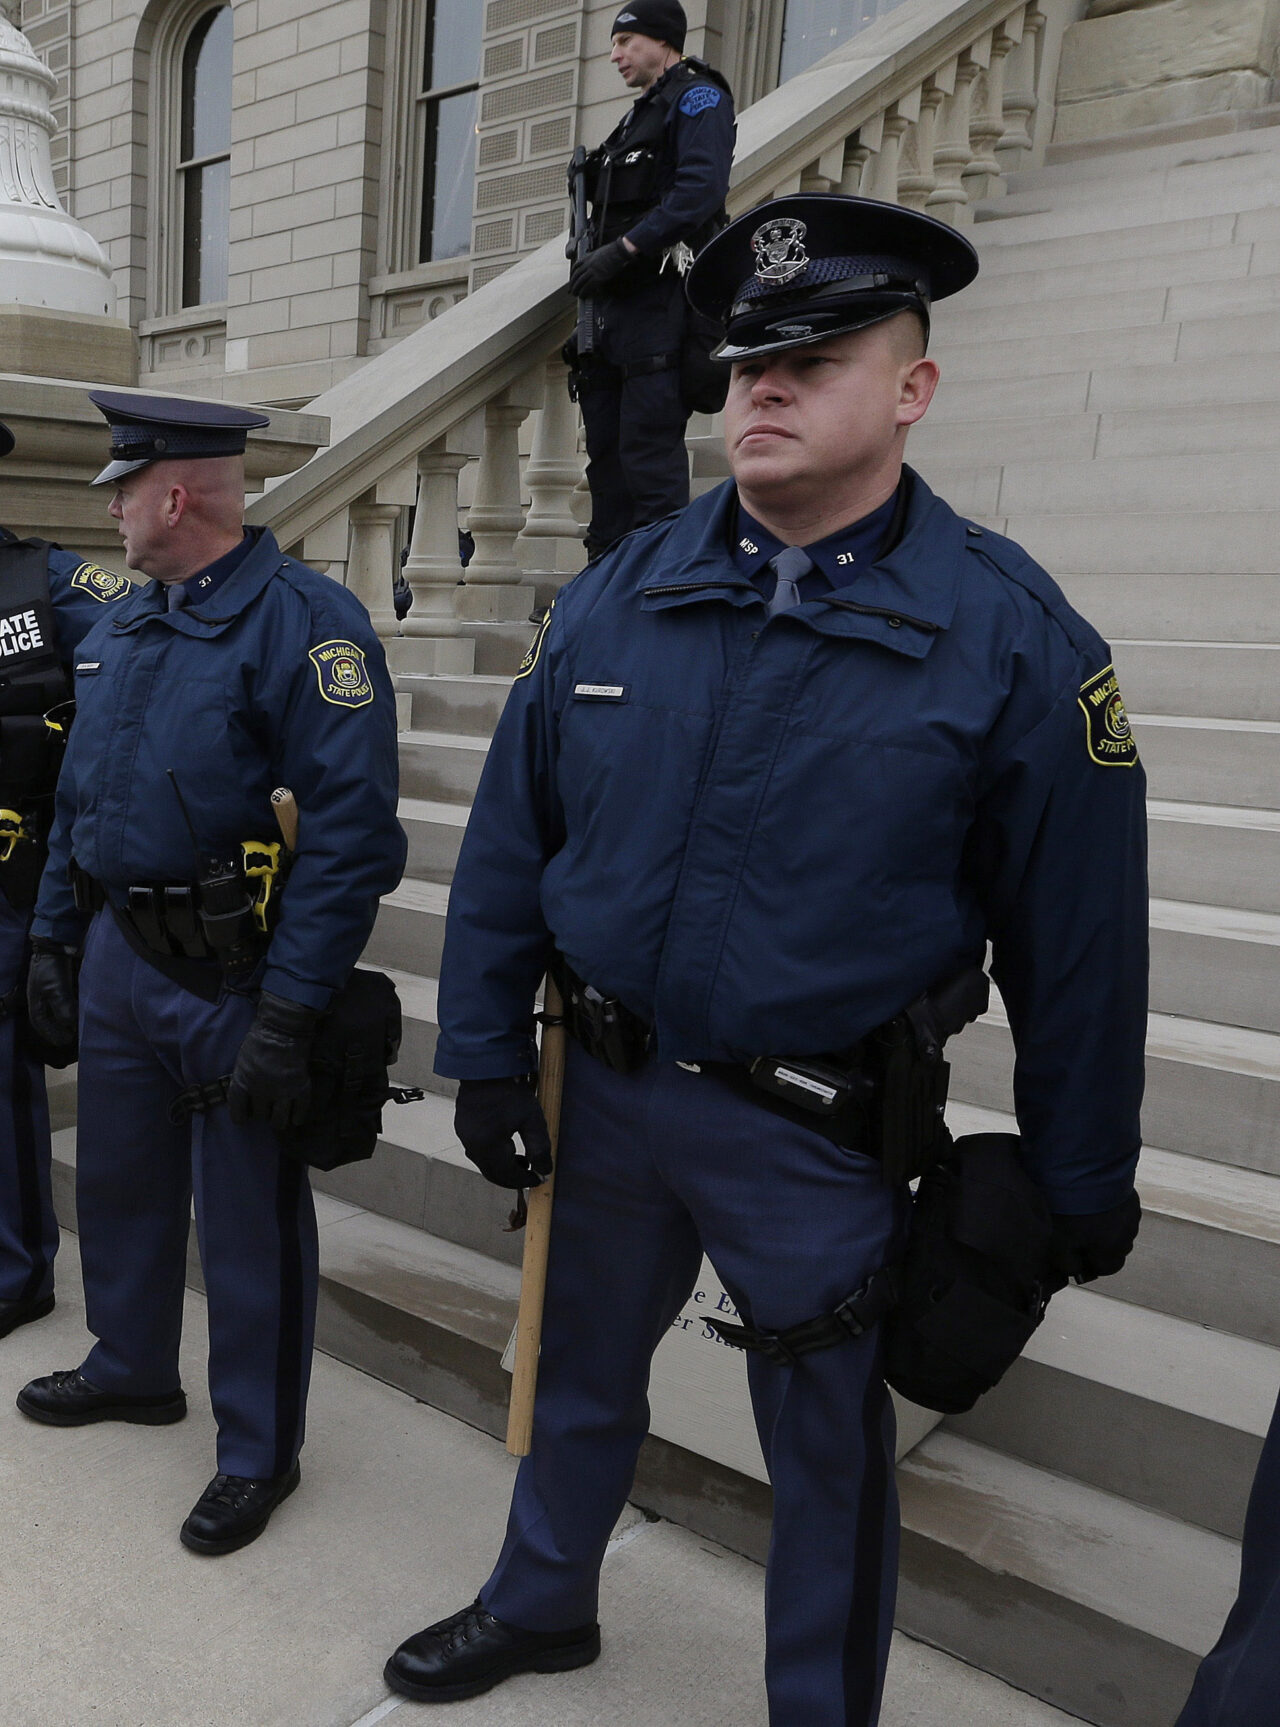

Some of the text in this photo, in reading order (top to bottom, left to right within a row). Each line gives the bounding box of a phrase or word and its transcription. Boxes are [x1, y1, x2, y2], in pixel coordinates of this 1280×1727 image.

[739, 537, 759, 555] MSP
[836, 552, 855, 565] 31
[318, 646, 360, 662] MICHIGAN
[327, 682, 370, 698] STATE POLICE
[1097, 738, 1128, 754] STATE
[714, 1291, 740, 1318] E
